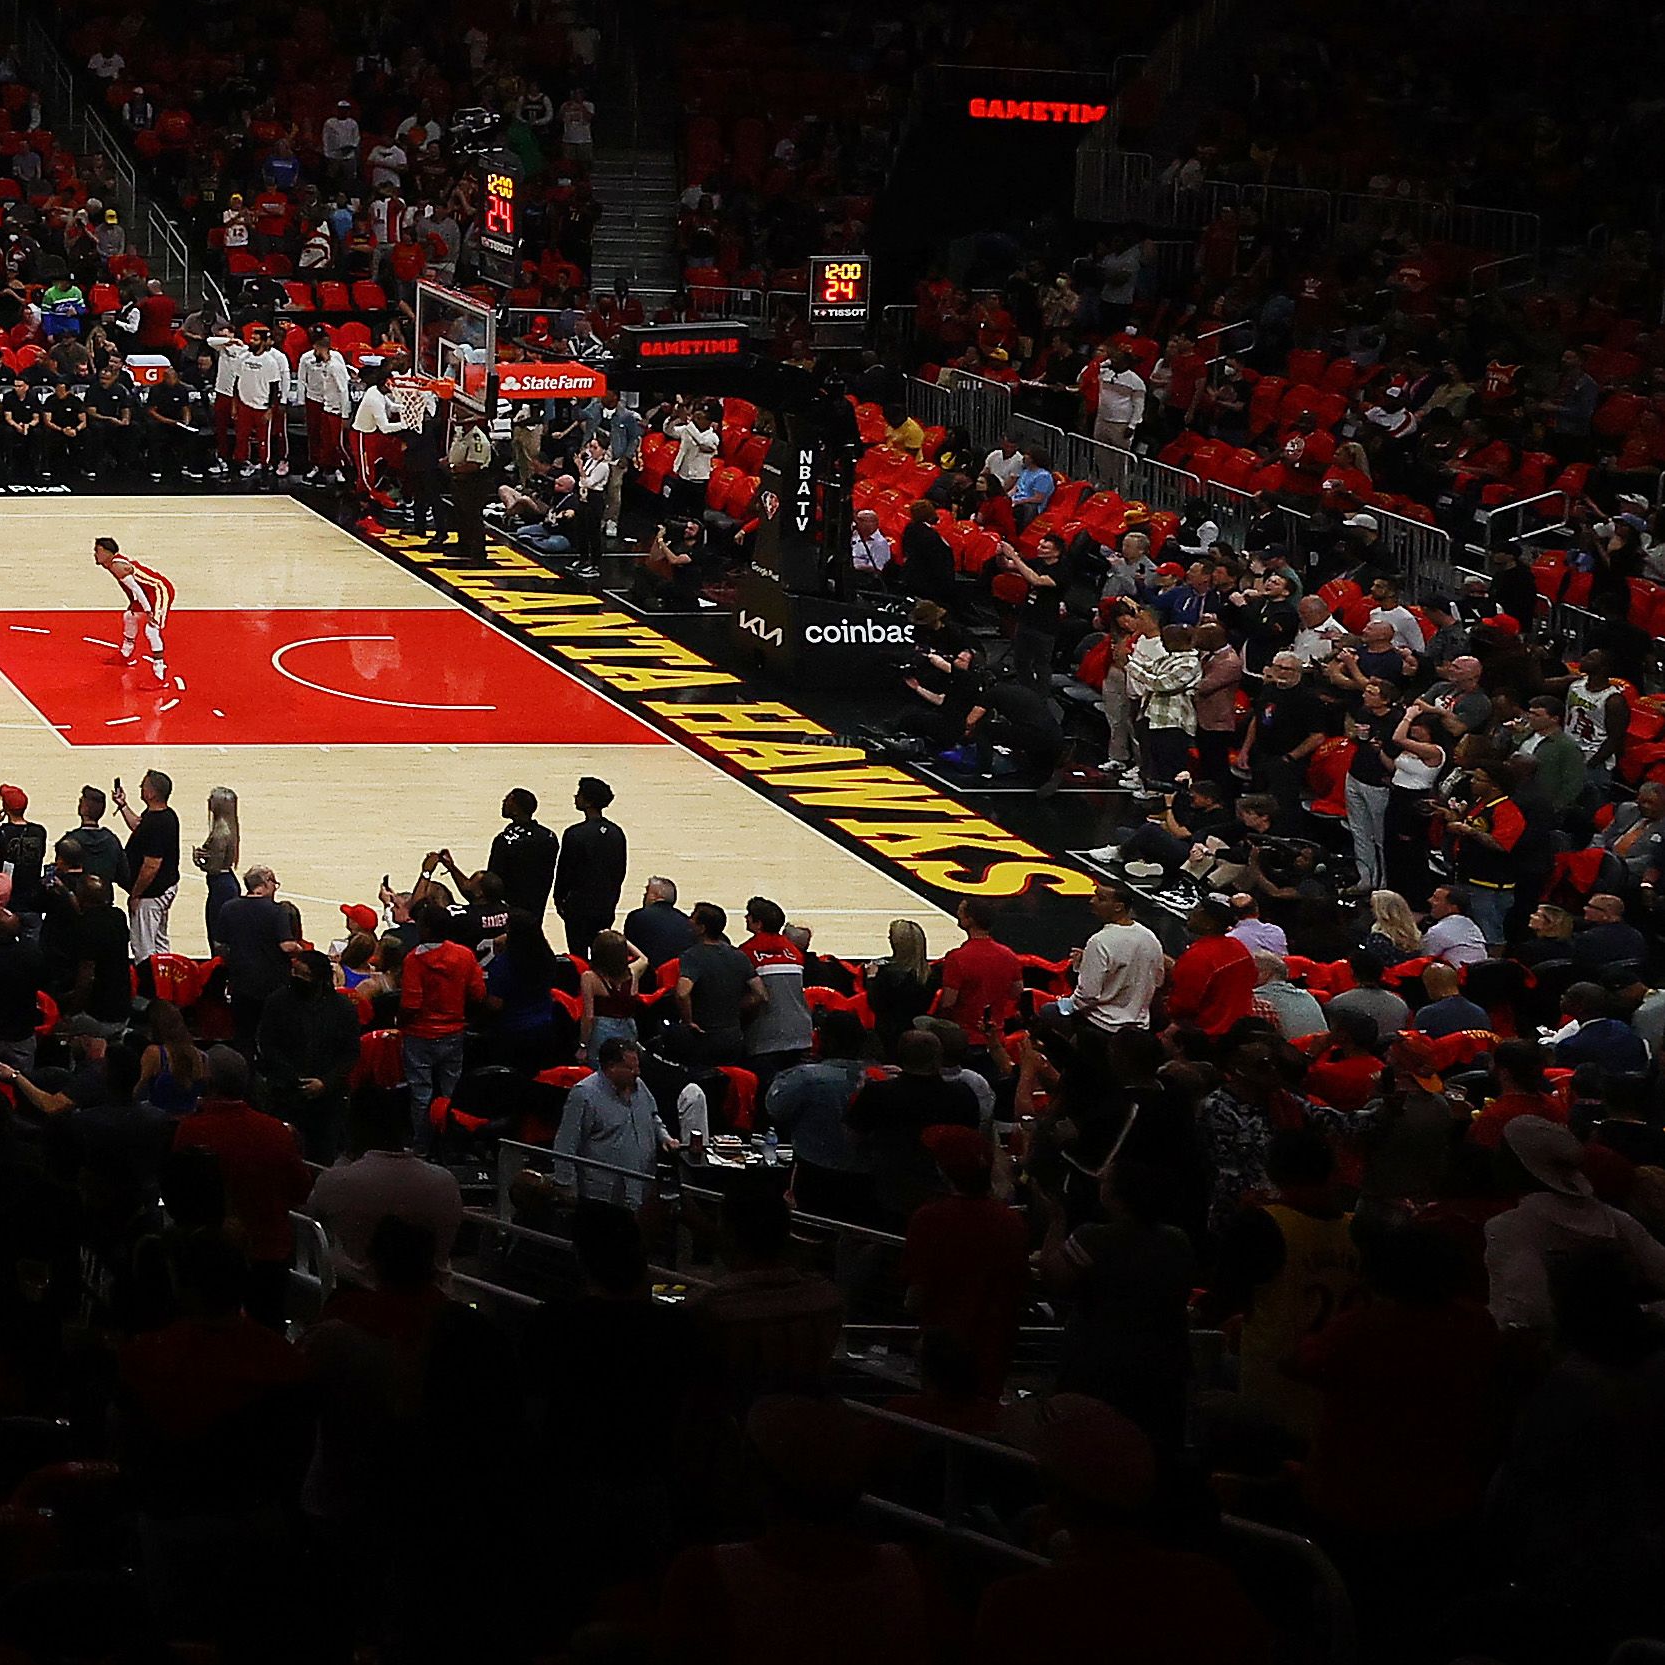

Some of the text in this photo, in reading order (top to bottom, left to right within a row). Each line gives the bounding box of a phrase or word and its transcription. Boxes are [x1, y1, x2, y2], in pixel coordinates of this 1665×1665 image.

[969, 98, 1108, 124] GAMETIM
[487, 196, 512, 233] 24
[825, 263, 861, 279] 12:00
[825, 280, 854, 302] 24
[828, 308, 866, 317] TISSOT
[640, 339, 738, 356] GAMETIME
[145, 368, 158, 382] G
[8, 484, 72, 493] Pixel
[795, 450, 813, 532] NBA TV
[805, 618, 915, 643] coinbas
[639, 700, 1099, 896] HAWKS
